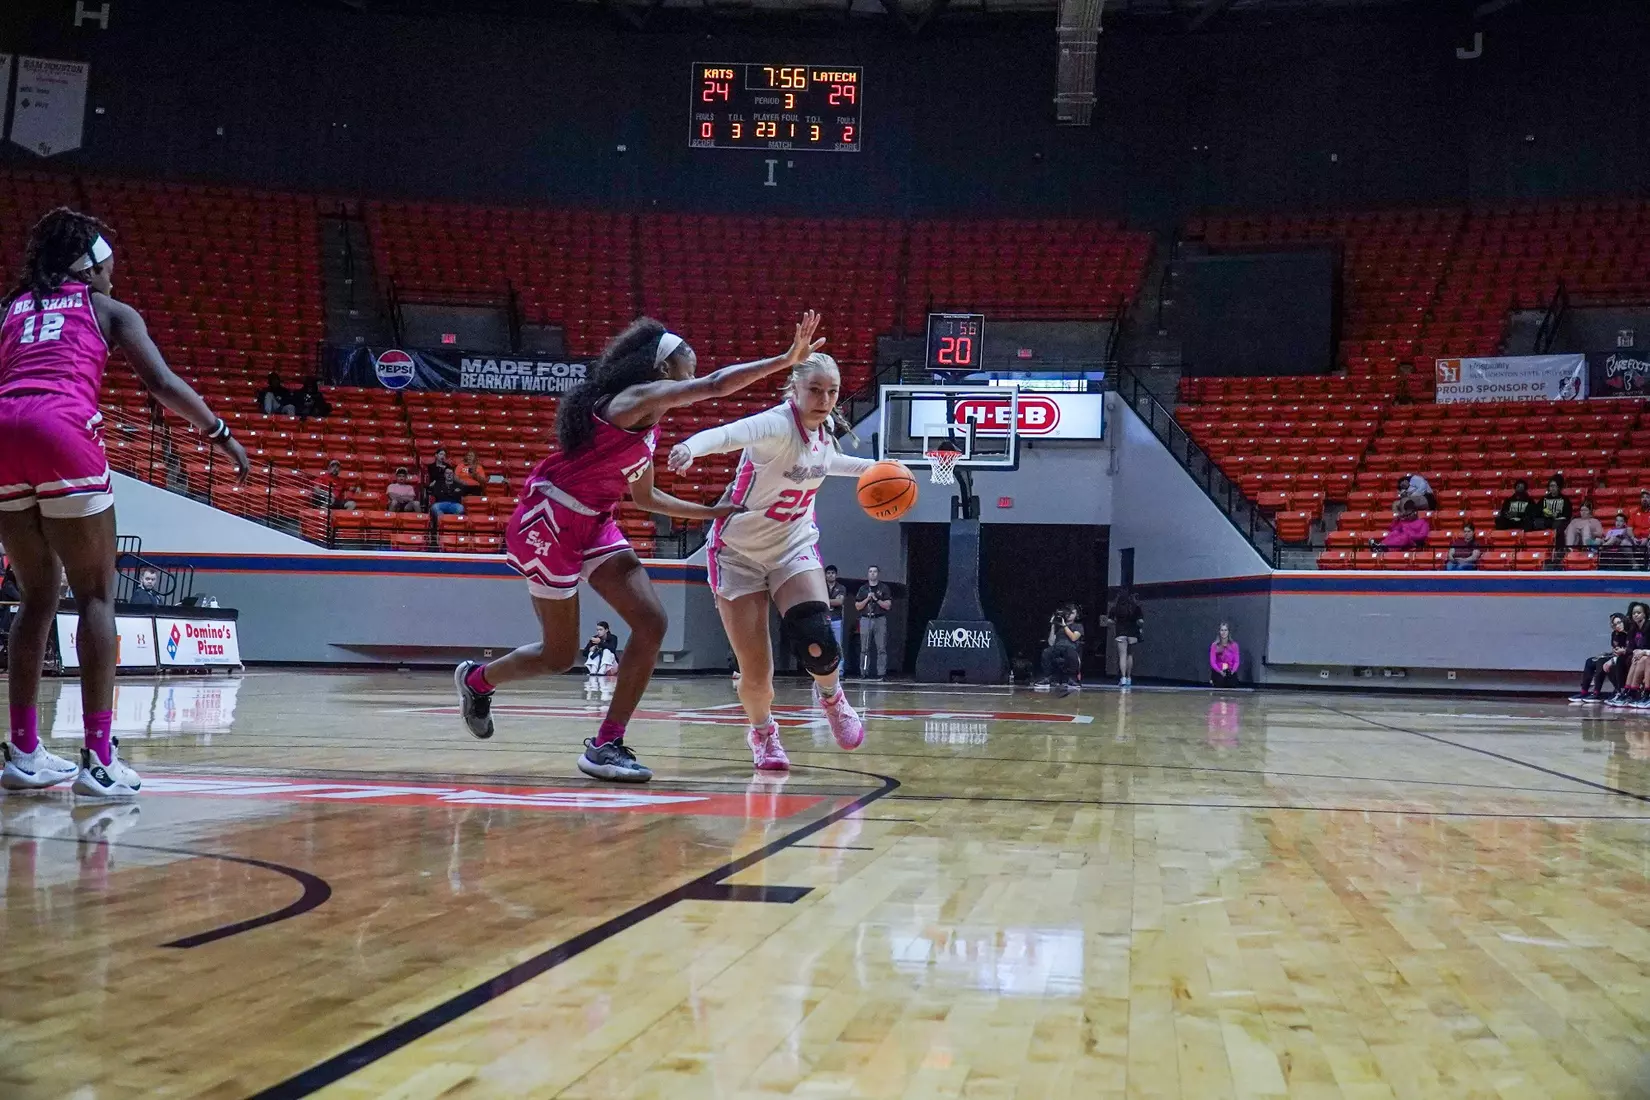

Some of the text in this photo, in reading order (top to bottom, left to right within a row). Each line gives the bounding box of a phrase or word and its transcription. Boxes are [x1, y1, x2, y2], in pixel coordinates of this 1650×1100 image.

[74, 0, 110, 30] H
[1456, 31, 1483, 59] J
[704, 69, 734, 79] KATS
[763, 67, 806, 89] 7:56
[813, 71, 857, 82] LATECH
[703, 81, 729, 102] 24
[829, 84, 855, 105] 29
[784, 93, 794, 109] 3
[753, 113, 799, 122] PLAYER FOUL
[701, 122, 711, 138] 0
[732, 123, 741, 139] 3
[756, 122, 776, 138] 23
[790, 123, 795, 138] 1
[810, 125, 820, 141] 3
[843, 126, 853, 142] 2
[20, 312, 65, 344] 12
[938, 337, 971, 364] 20
[377, 364, 412, 374] PEPSI
[461, 358, 586, 378] MADE FOR
[460, 373, 520, 390] BEARKAT
[1437, 383, 1546, 394] PROUD SPONSOR OF
[964, 406, 1047, 425] H-E-B
[764, 488, 818, 522] 25
[185, 623, 231, 639] Domino's
[927, 628, 992, 641] MEMORIAL
[197, 640, 224, 655] Pizza
[927, 638, 991, 648] HERMANN
